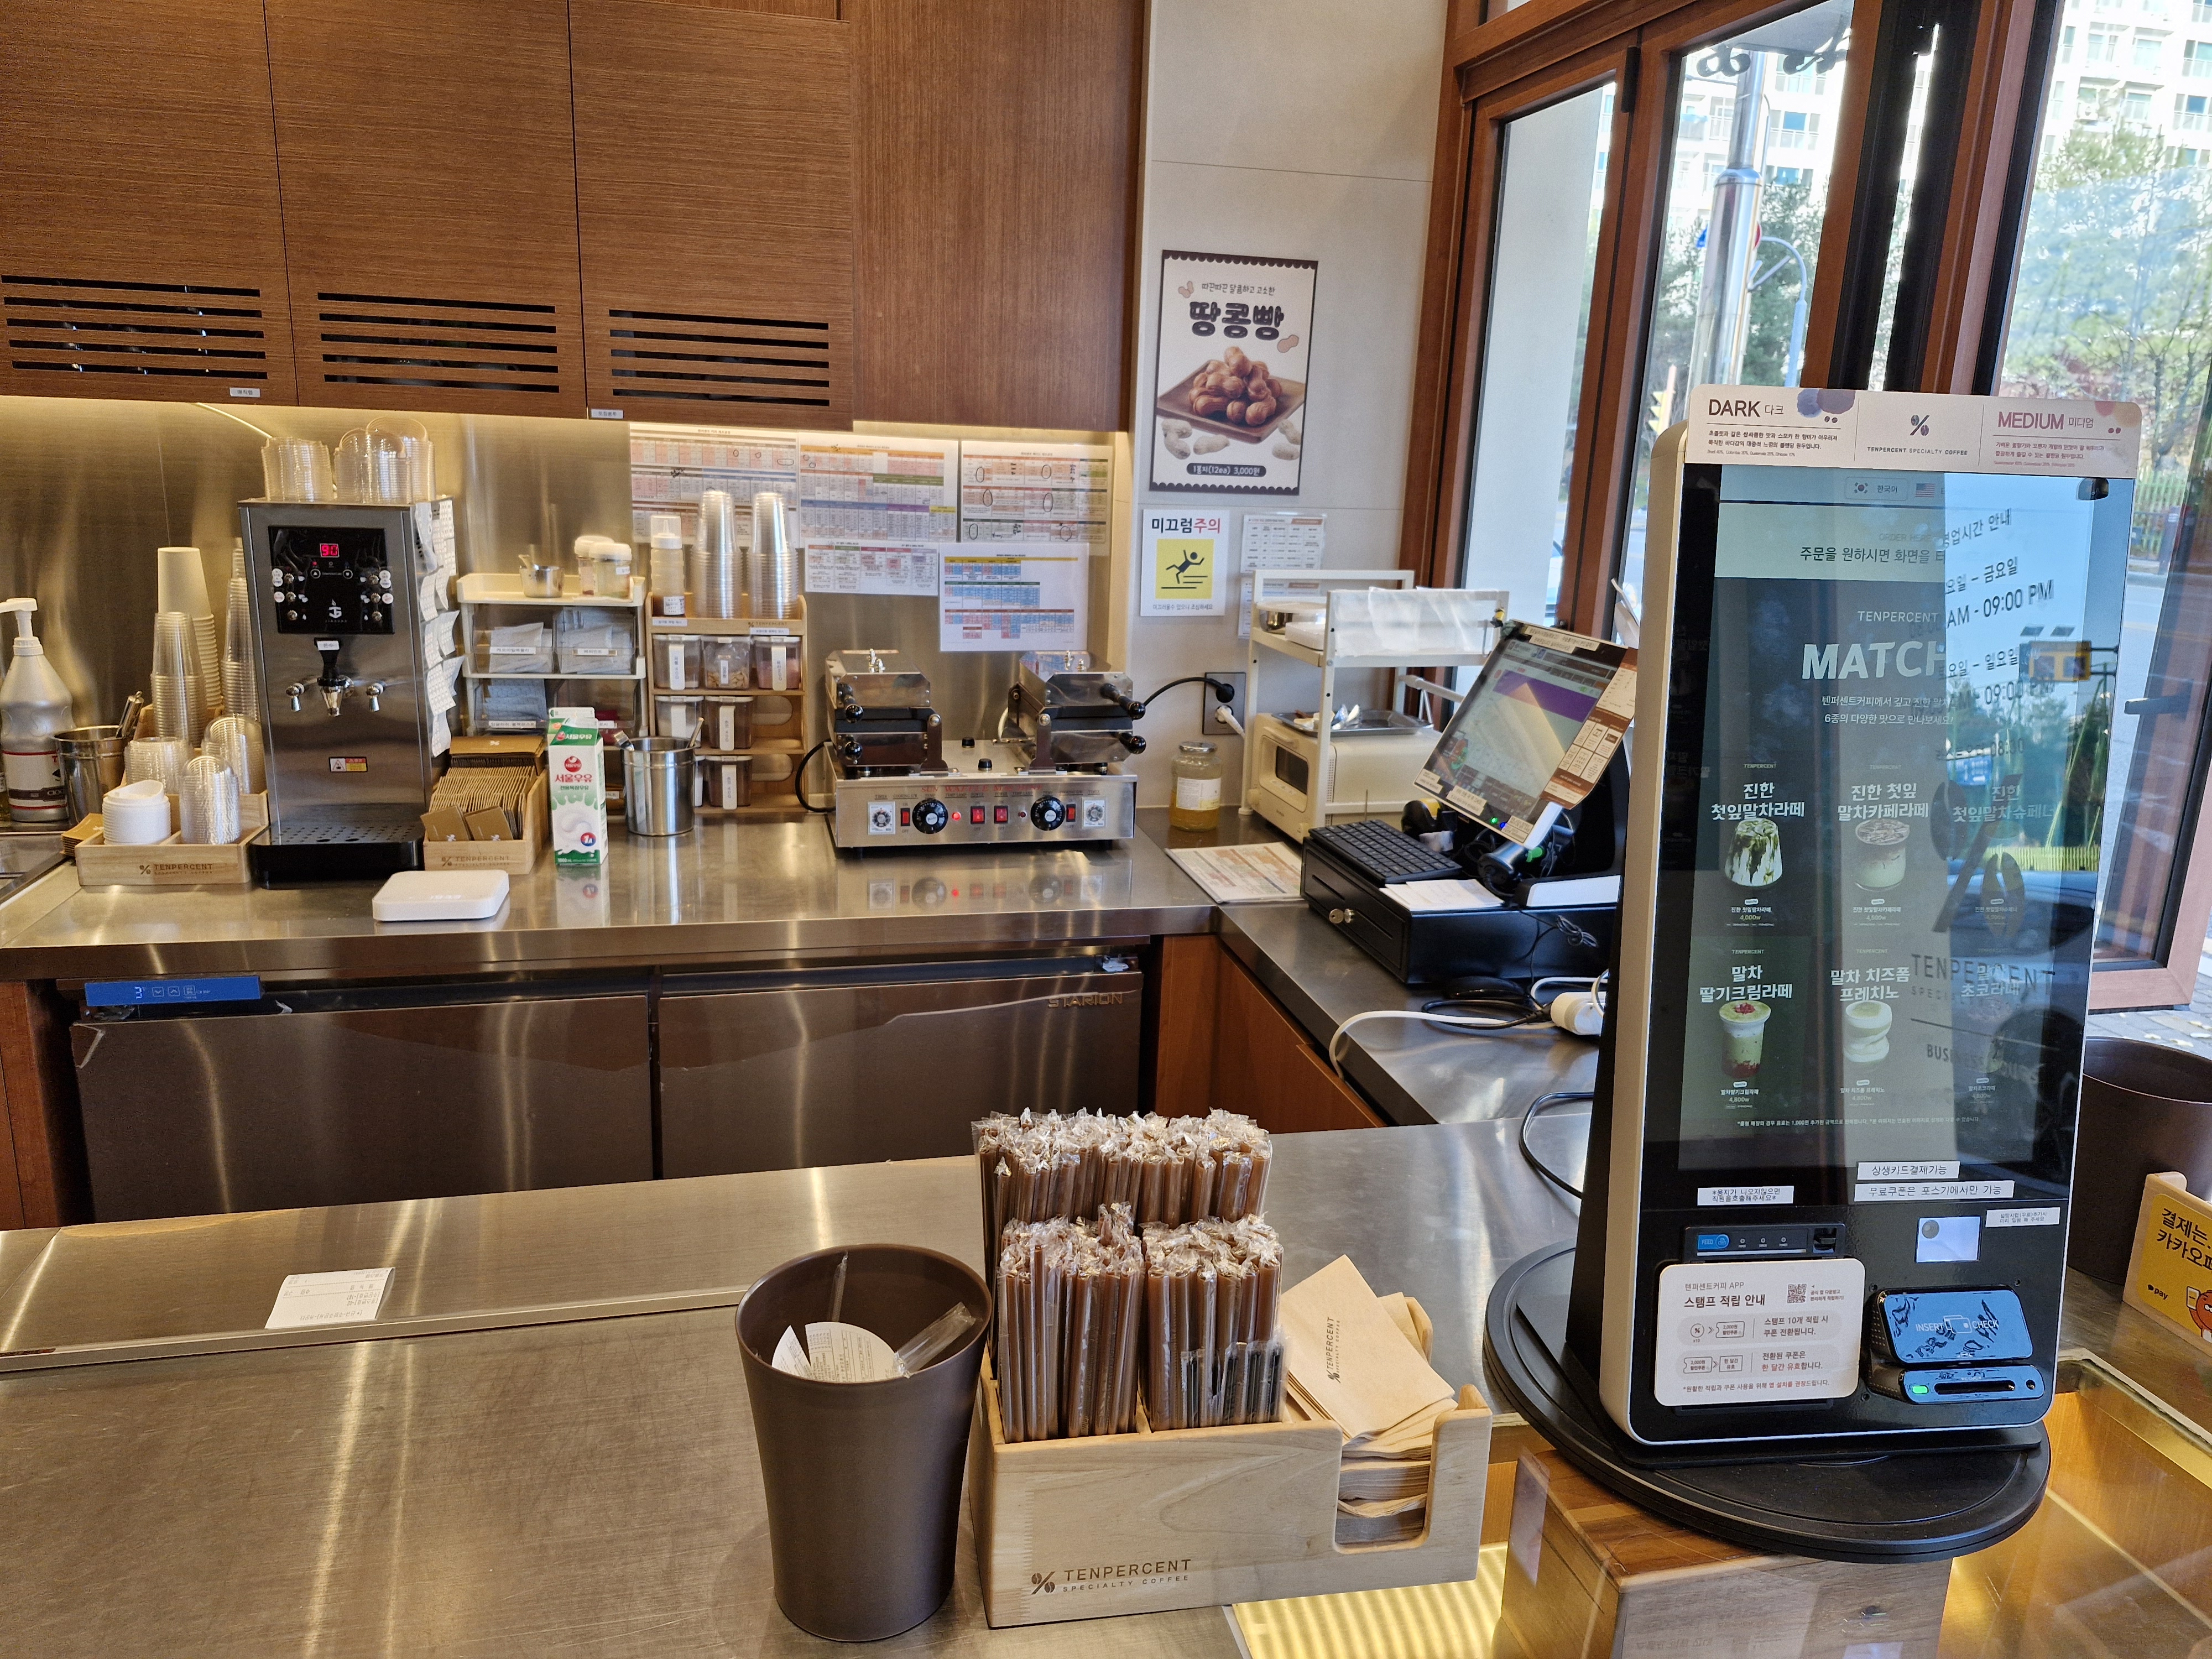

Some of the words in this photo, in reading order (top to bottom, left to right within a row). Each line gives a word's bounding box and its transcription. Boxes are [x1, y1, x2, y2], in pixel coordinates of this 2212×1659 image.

[1202, 283, 1228, 293] 따끈따끈
[1230, 284, 1255, 294] 달콤하고
[1256, 286, 1275, 296] 고소한
[1190, 301, 1284, 341] 땅콩빵
[1708, 399, 1761, 418] DARK
[1765, 404, 1784, 415] 다크
[1998, 411, 2064, 430] MEDIUM
[2068, 417, 2094, 428] 미디엄
[1193, 465, 1230, 475] 1봉지(12ea)
[1233, 467, 1260, 476] 3,000원
[1877, 485, 1898, 494] 한국어
[1151, 518, 1221, 534] 미끄럼주의
[1988, 508, 2012, 532] 안내
[1800, 546, 1836, 561] 주문을
[1842, 547, 1890, 563] 원하시면
[1895, 549, 1930, 564] 화면을
[1944, 573, 1966, 595] 요일
[1984, 556, 2018, 584] 금요일
[1947, 604, 1970, 629] AM
[1983, 588, 2022, 618] 09:00
[2028, 578, 2054, 605] PM
[1857, 611, 1939, 623] TENPERCENT
[1985, 647, 2018, 671] 일요일
[1985, 680, 2023, 705] 09:00
[1822, 696, 1891, 707] 텐퍼센트커피에서
[1895, 697, 1911, 707] 깊고
[1913, 698, 1931, 708] 진한
[1824, 713, 1848, 724] 6종의
[1851, 714, 1877, 724] 다양한
[1880, 714, 1905, 724] 맛으로
[1908, 714, 1953, 725] 만나보세요!
[555, 774, 592, 783] 서울우유
[944, 784, 989, 792] WAFFLE
[1743, 781, 1775, 800] 진한
[1851, 784, 1882, 801] 진한
[1887, 782, 1917, 800] 첫잎
[1991, 785, 2021, 802] 진한
[1710, 801, 1805, 820] 첫잎말차라떼
[1837, 802, 1929, 821] 말차카페라떼
[1731, 964, 1763, 983] 말차
[1830, 969, 1860, 986] 말차
[1865, 966, 1910, 983] 치즈폼
[1699, 984, 1793, 1003] 딸기크림라떼
[1839, 985, 1900, 1002] 프레치노
[1961, 982, 2019, 998] 초코라떼
[1048, 993, 1123, 1008] STARION
[1871, 1165, 1947, 1176] 상생카드결제가능
[1869, 1186, 1916, 1197] 무료쿠폰은
[1921, 1185, 1979, 1196] 포스기에서만
[1983, 1185, 2002, 1195] 가능
[1684, 1282, 1727, 1291] 텐퍼센트커피
[2154, 1287, 2168, 1300] pay
[1683, 1295, 1717, 1308] 스탬프
[1719, 1294, 1741, 1307] 적립
[1744, 1293, 1766, 1306] 안내
[1764, 1316, 1785, 1326] 스탬프
[1788, 1316, 1803, 1324] 10개
[1806, 1315, 1819, 1324] 적립
[1821, 1315, 1828, 1323] 시
[1915, 1322, 1944, 1332] INSERT
[1971, 1320, 2000, 1329] CHECK
[1763, 1328, 1778, 1338] 쿠폰
[1780, 1327, 1816, 1337] 전환됩니다.
[1326, 1316, 1334, 1370] TENPERCENT
[1762, 1351, 1783, 1361] 전환된
[1785, 1350, 1806, 1360] 쿠폰은
[1762, 1363, 1769, 1373] 한
[1771, 1363, 1785, 1372] 달간
[1787, 1361, 1823, 1371] 유효합니다.
[1705, 1384, 1722, 1392] 적립과
[1724, 1383, 1735, 1391] 쿠폰
[1737, 1382, 1753, 1391] 사용을
[1756, 1381, 1767, 1390] 위해
[1776, 1380, 1793, 1389] 설치를
[1795, 1379, 1830, 1388] 권장드립니다.
[1063, 1558, 1192, 1582] TENPERCENT
[1063, 1580, 1133, 1593] SPECIALTY
[1142, 1575, 1189, 1585] COFFEE
